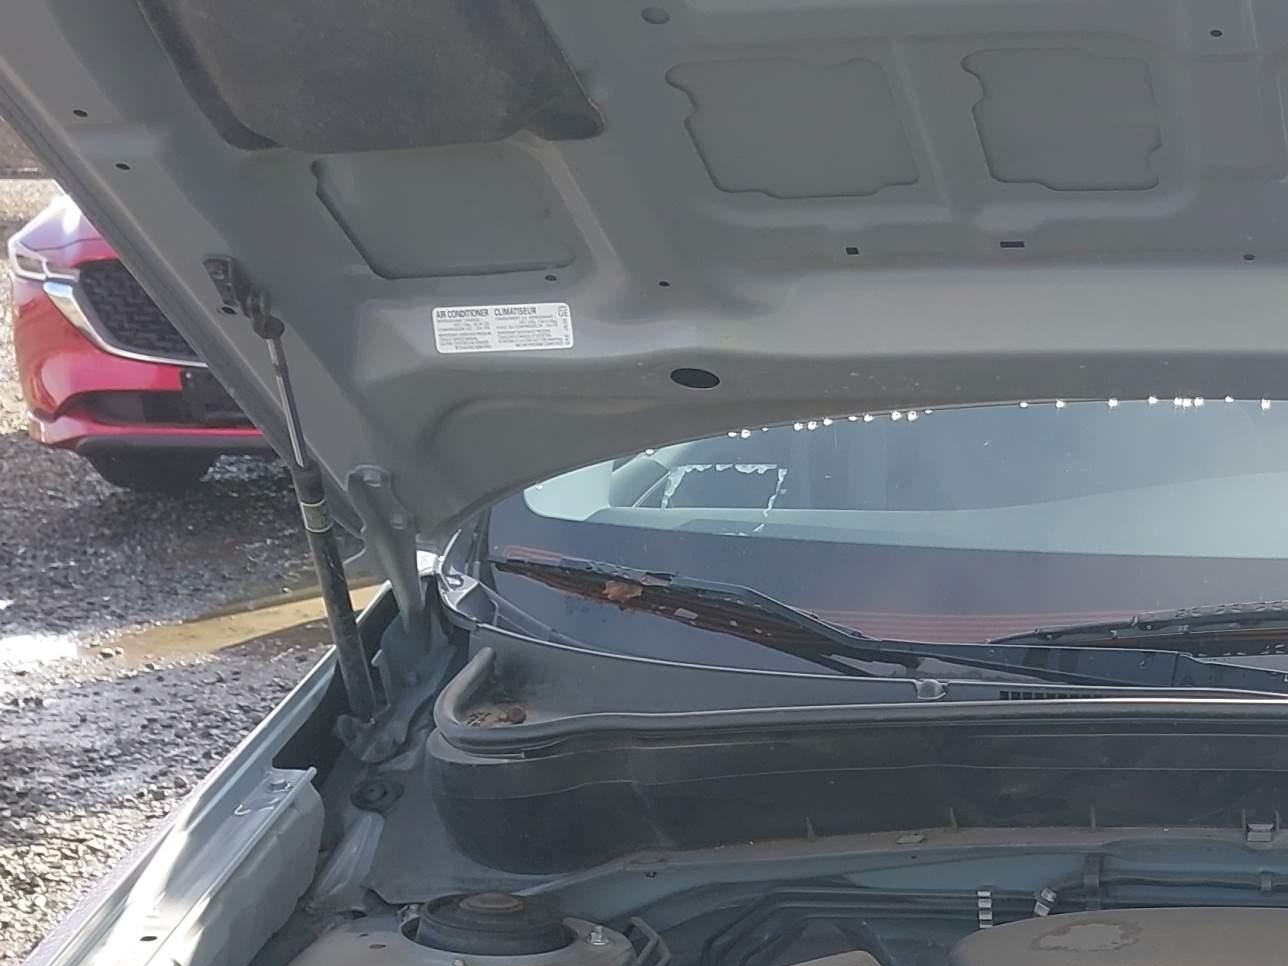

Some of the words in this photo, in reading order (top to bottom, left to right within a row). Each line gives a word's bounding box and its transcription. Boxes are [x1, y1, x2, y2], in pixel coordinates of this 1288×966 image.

[436, 310, 447, 319] AIR
[447, 308, 489, 319] CONDITIONER
[494, 306, 537, 317] CLIMATISEUR
